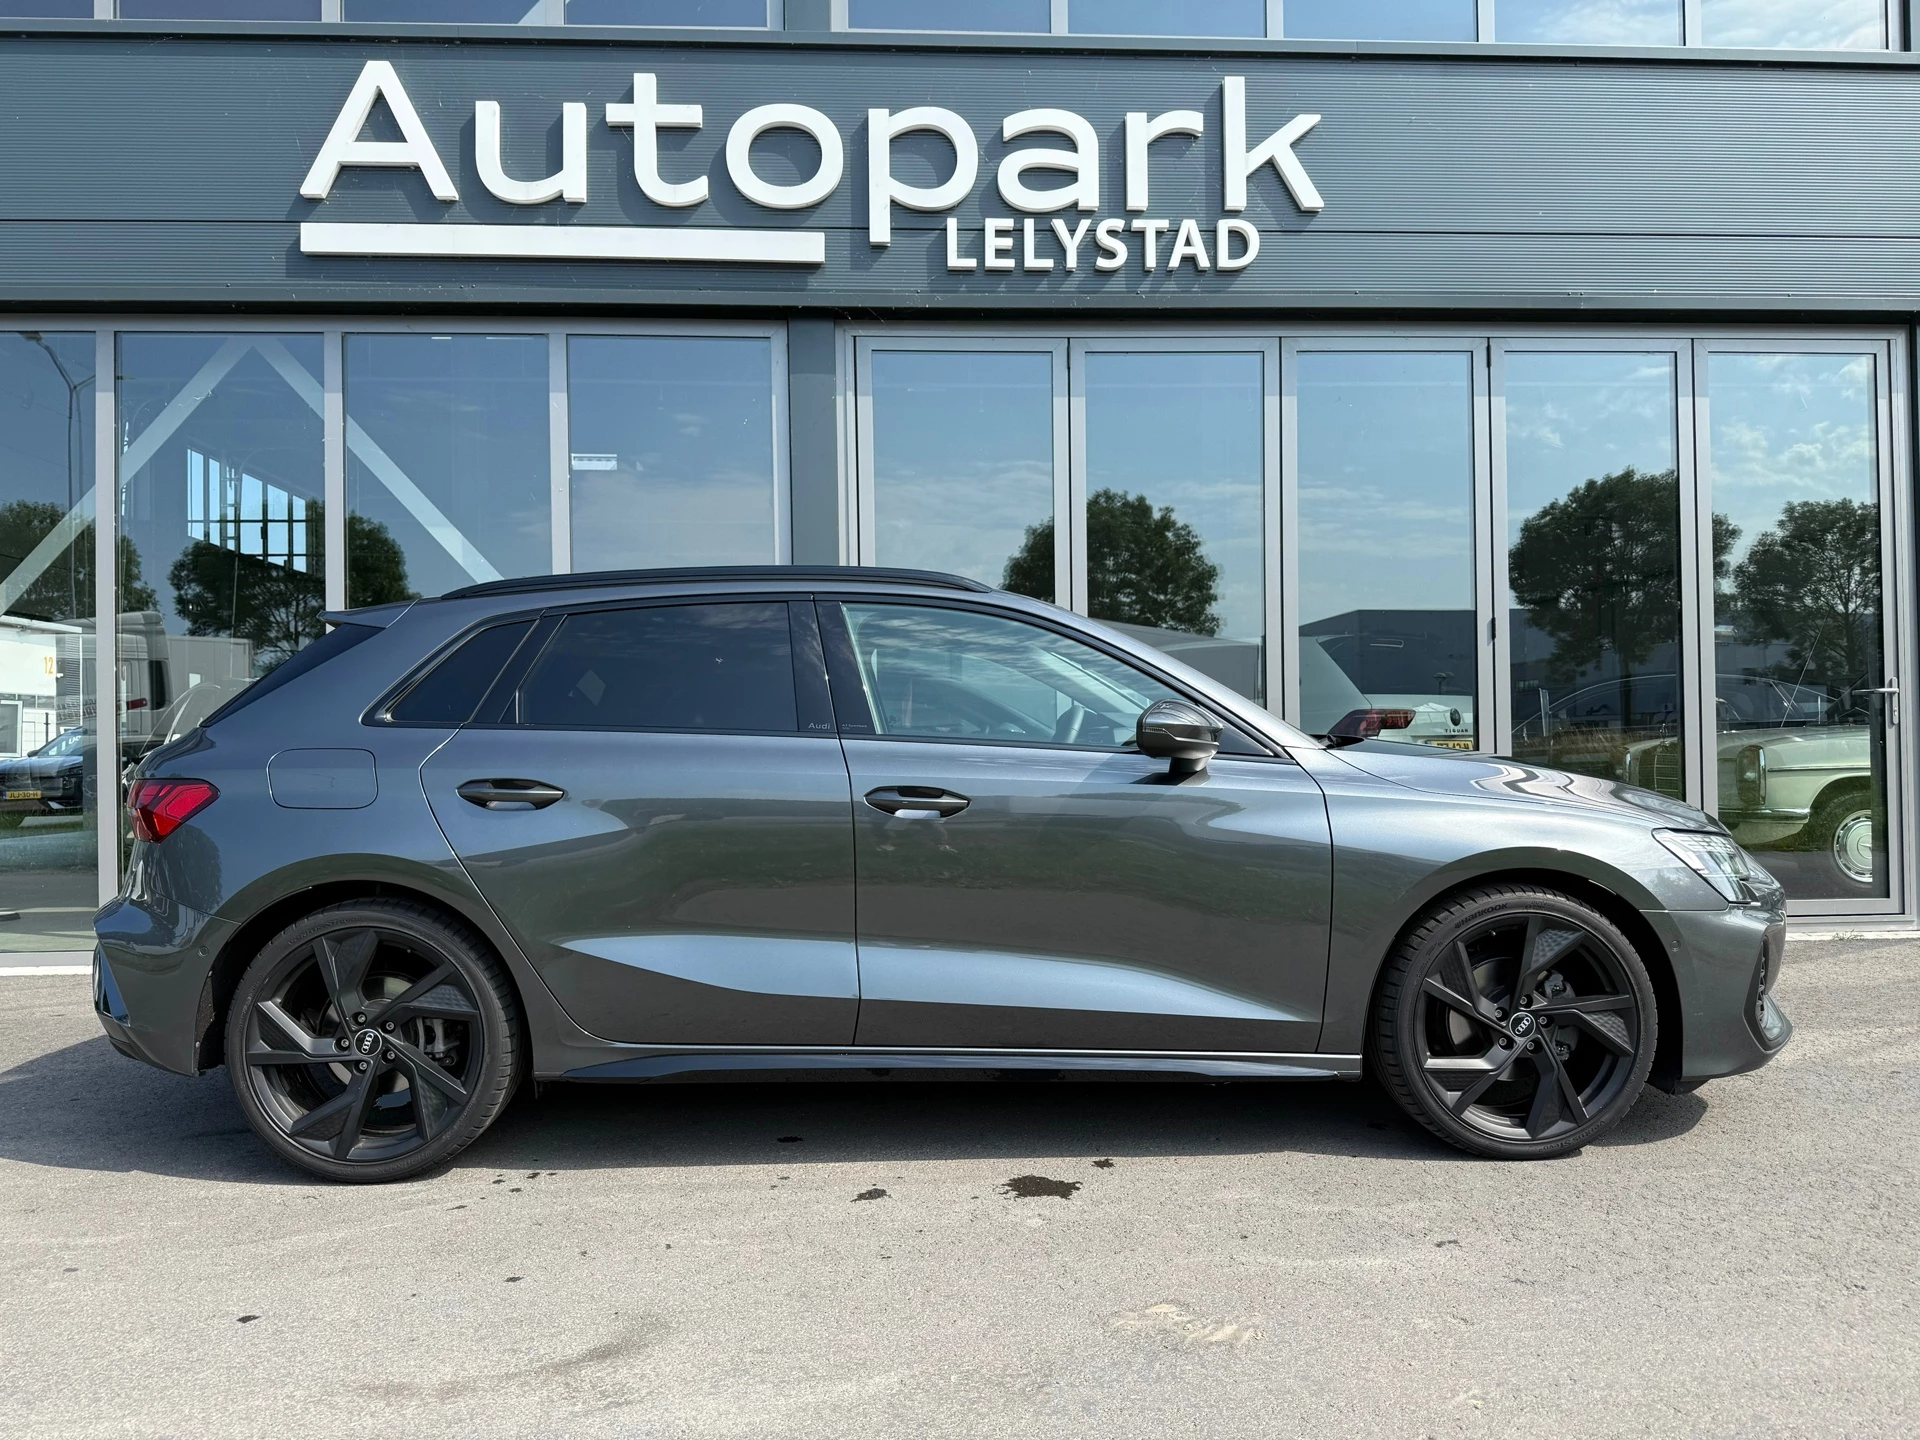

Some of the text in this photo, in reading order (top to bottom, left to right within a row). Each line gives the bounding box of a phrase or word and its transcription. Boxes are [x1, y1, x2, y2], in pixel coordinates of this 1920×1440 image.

[299, 60, 1326, 248] Autopark
[945, 216, 1261, 274] LELYSTAD
[44, 656, 53, 674] 12
[808, 722, 831, 730] Audi
